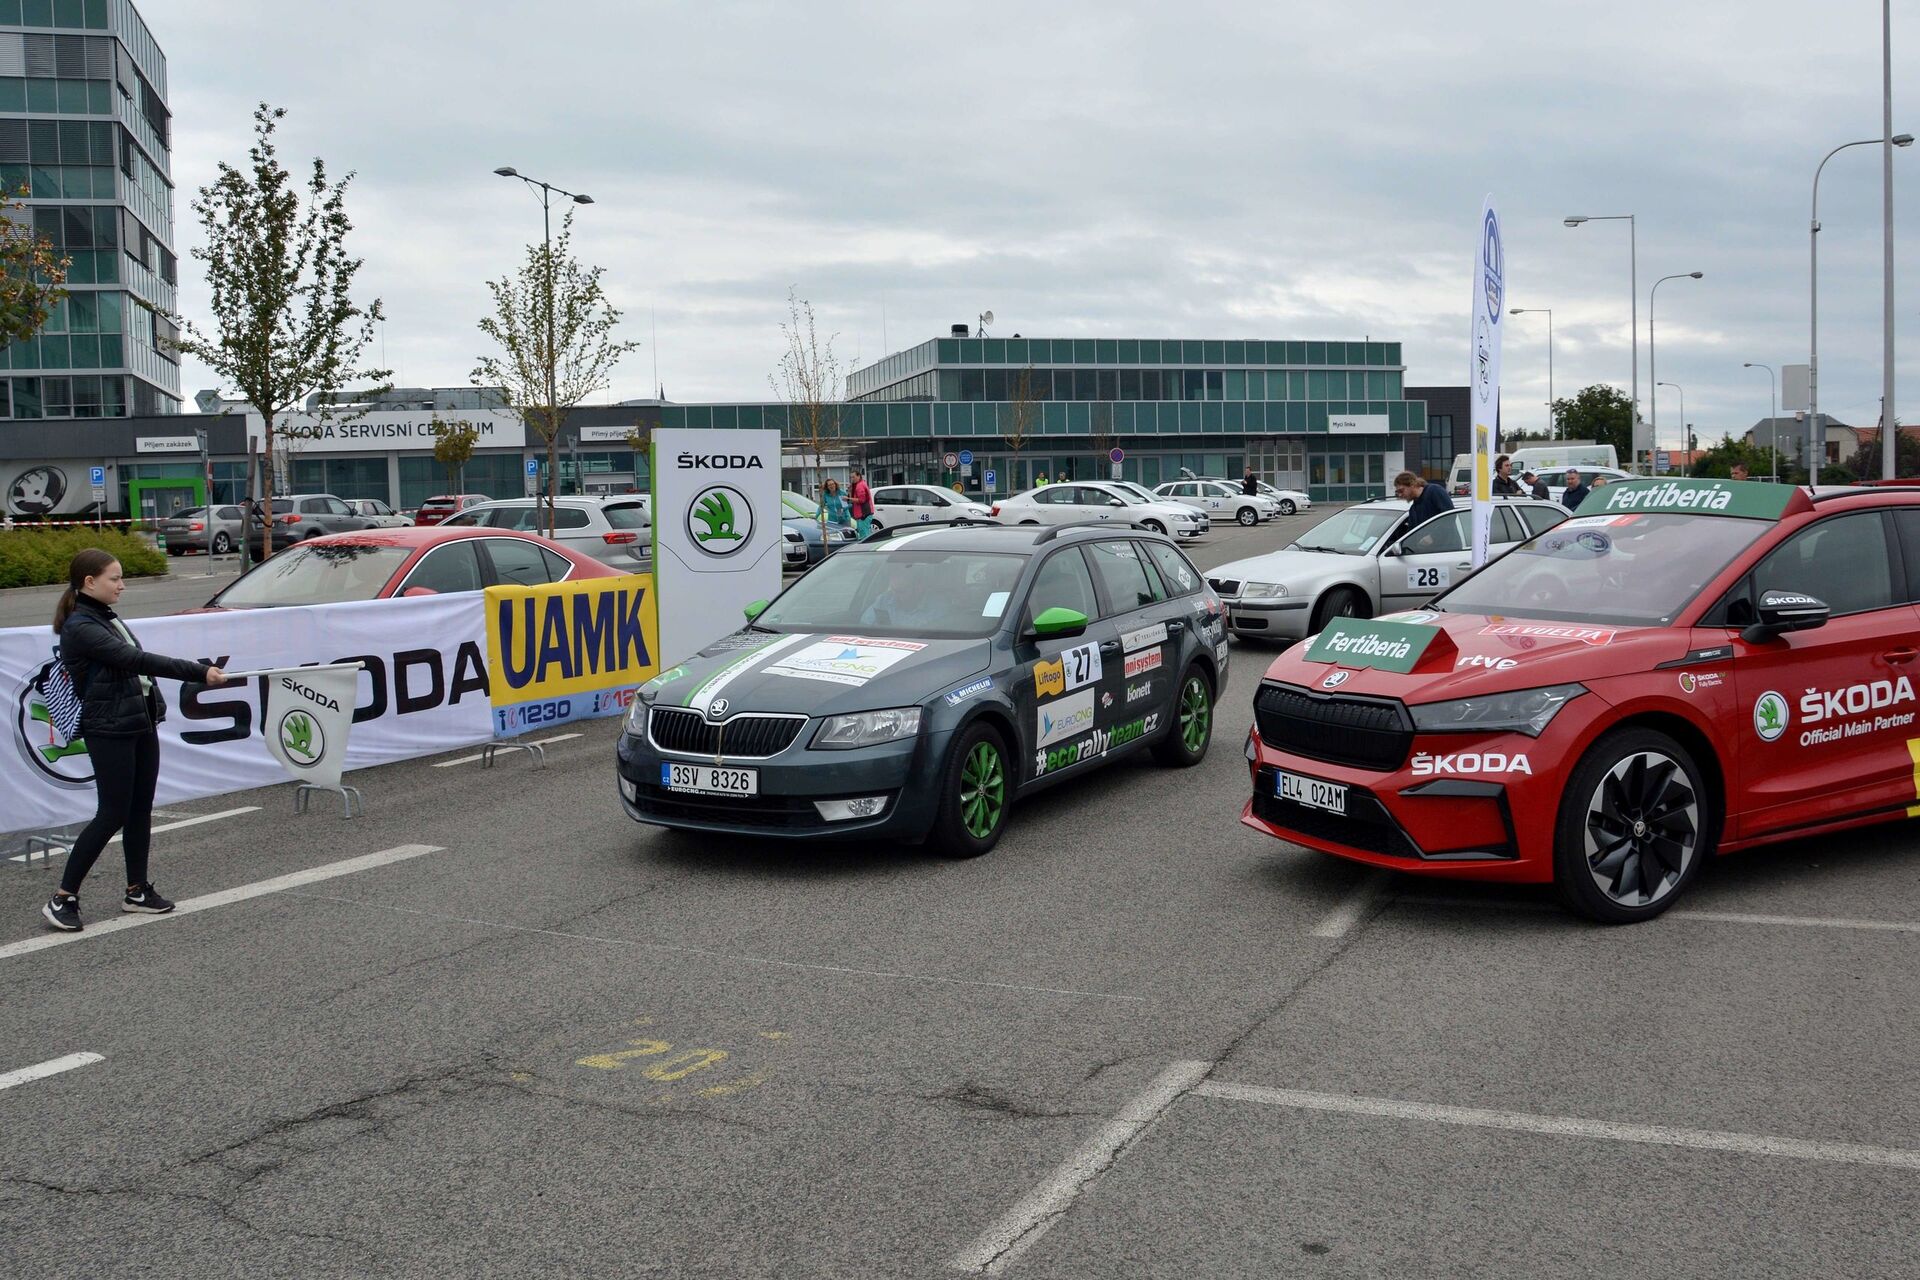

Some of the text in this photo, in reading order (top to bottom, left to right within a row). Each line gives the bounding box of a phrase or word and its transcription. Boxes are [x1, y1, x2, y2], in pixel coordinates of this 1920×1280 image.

[281, 424, 334, 439] KODA
[340, 421, 412, 438] SERVISNÍ
[144, 440, 193, 448] Příjem zakázek
[677, 451, 764, 469] ŠKODA
[1212, 501, 1219, 509] 34
[1605, 483, 1732, 510] Fertiberia
[1417, 568, 1439, 586] 28
[499, 588, 652, 690] UAMK
[1325, 631, 1412, 659] Fertiberia
[1492, 626, 1602, 641] LA VUELTA
[1072, 647, 1091, 684] 27
[1457, 654, 1519, 670] rtve
[958, 679, 991, 697] MICHELIN
[1038, 671, 1061, 685] Liftago
[179, 641, 491, 745] ŠODA
[1800, 676, 1916, 724] ŠKODA
[518, 700, 571, 725] 1230
[1800, 712, 1916, 747] Official Main Partner
[1411, 752, 1533, 775] ŠKODA
[673, 766, 699, 786] 3SV
[711, 769, 749, 790] 8326
[1282, 775, 1343, 810] EL4 02AM
